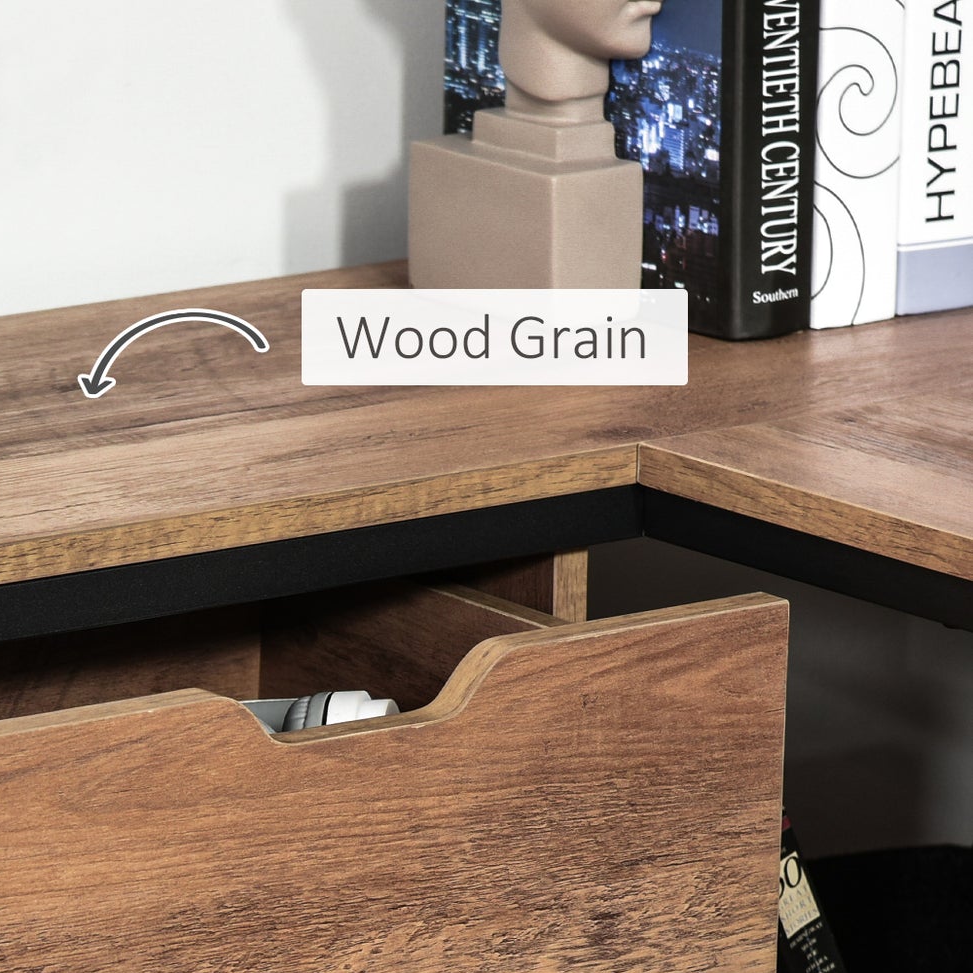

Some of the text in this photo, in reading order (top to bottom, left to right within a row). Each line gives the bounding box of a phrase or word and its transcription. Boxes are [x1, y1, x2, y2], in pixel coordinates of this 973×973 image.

[925, 0, 962, 223] HYPEBEA
[760, 140, 800, 275] CENTURY
[752, 288, 799, 304] Southern
